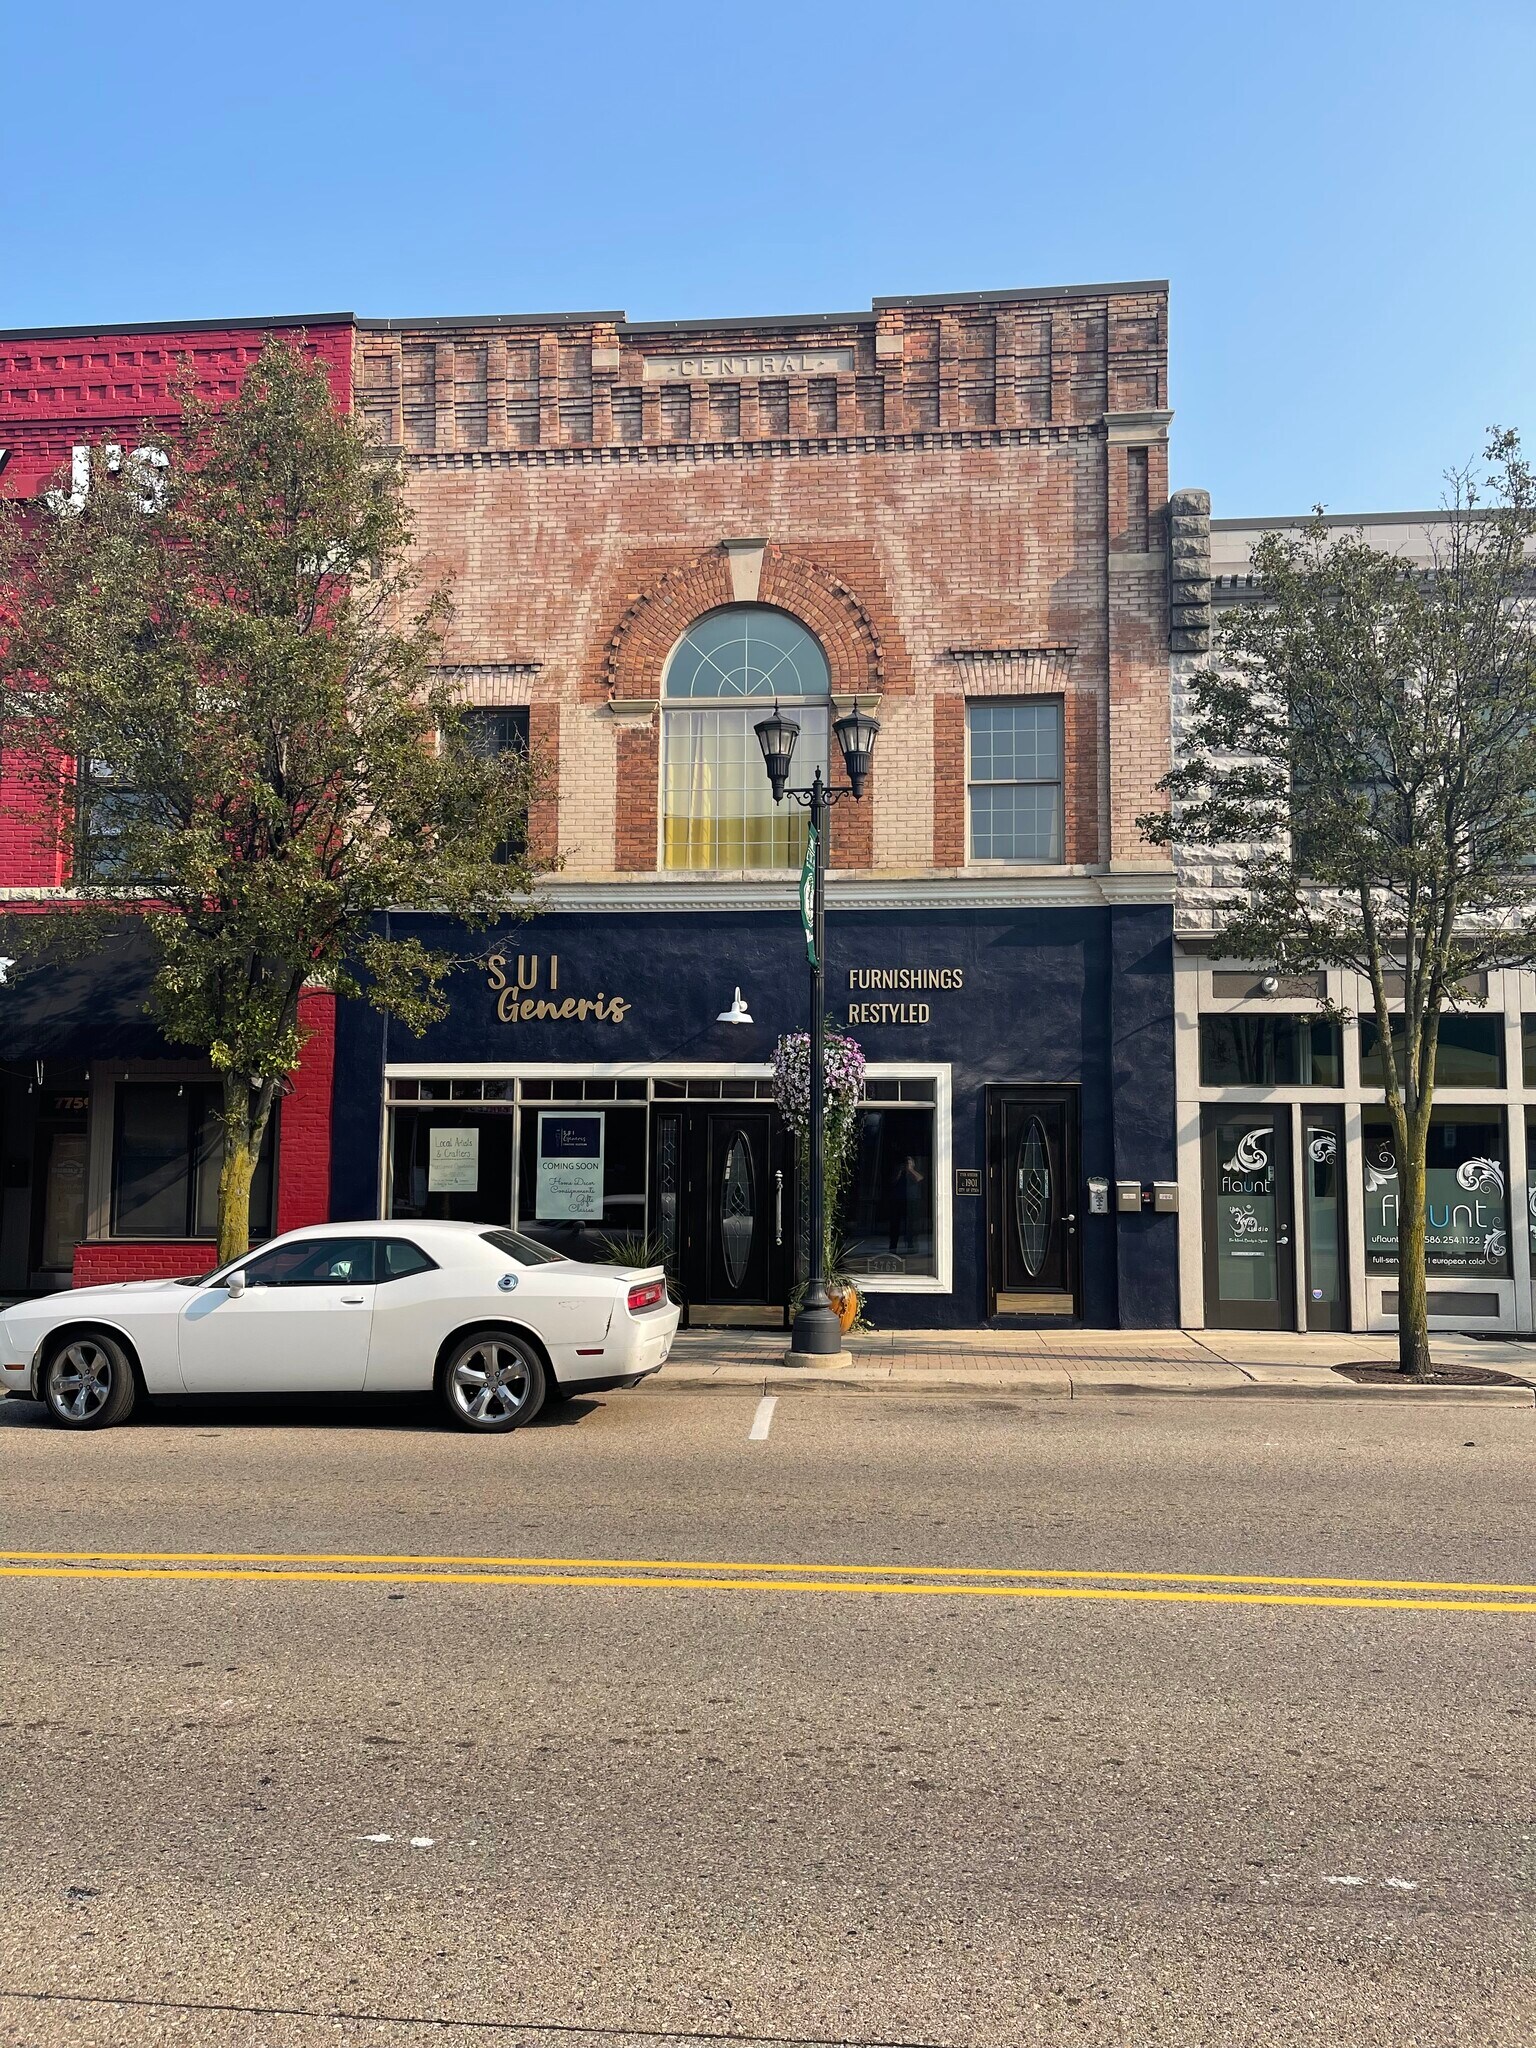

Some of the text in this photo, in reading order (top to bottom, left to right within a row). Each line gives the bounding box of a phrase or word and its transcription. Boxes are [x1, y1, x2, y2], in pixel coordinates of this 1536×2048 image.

[680, 355, 814, 376] CENTRAL
[487, 954, 558, 990] SUI
[849, 968, 963, 989] FURNISHINGS
[497, 986, 631, 1023] Generis
[848, 1003, 930, 1024] RESTYLED
[435, 1136, 452, 1148] Local
[542, 1162, 599, 1170] COMING SOON
[549, 1177, 595, 1186] Home Decor
[1222, 1176, 1271, 1193] flaunt
[1382, 1194, 1488, 1228] flunt
[1424, 1235, 1480, 1244] 586.254.1122
[1372, 1256, 1400, 1264] full-serv
[1432, 1258, 1467, 1266] european
